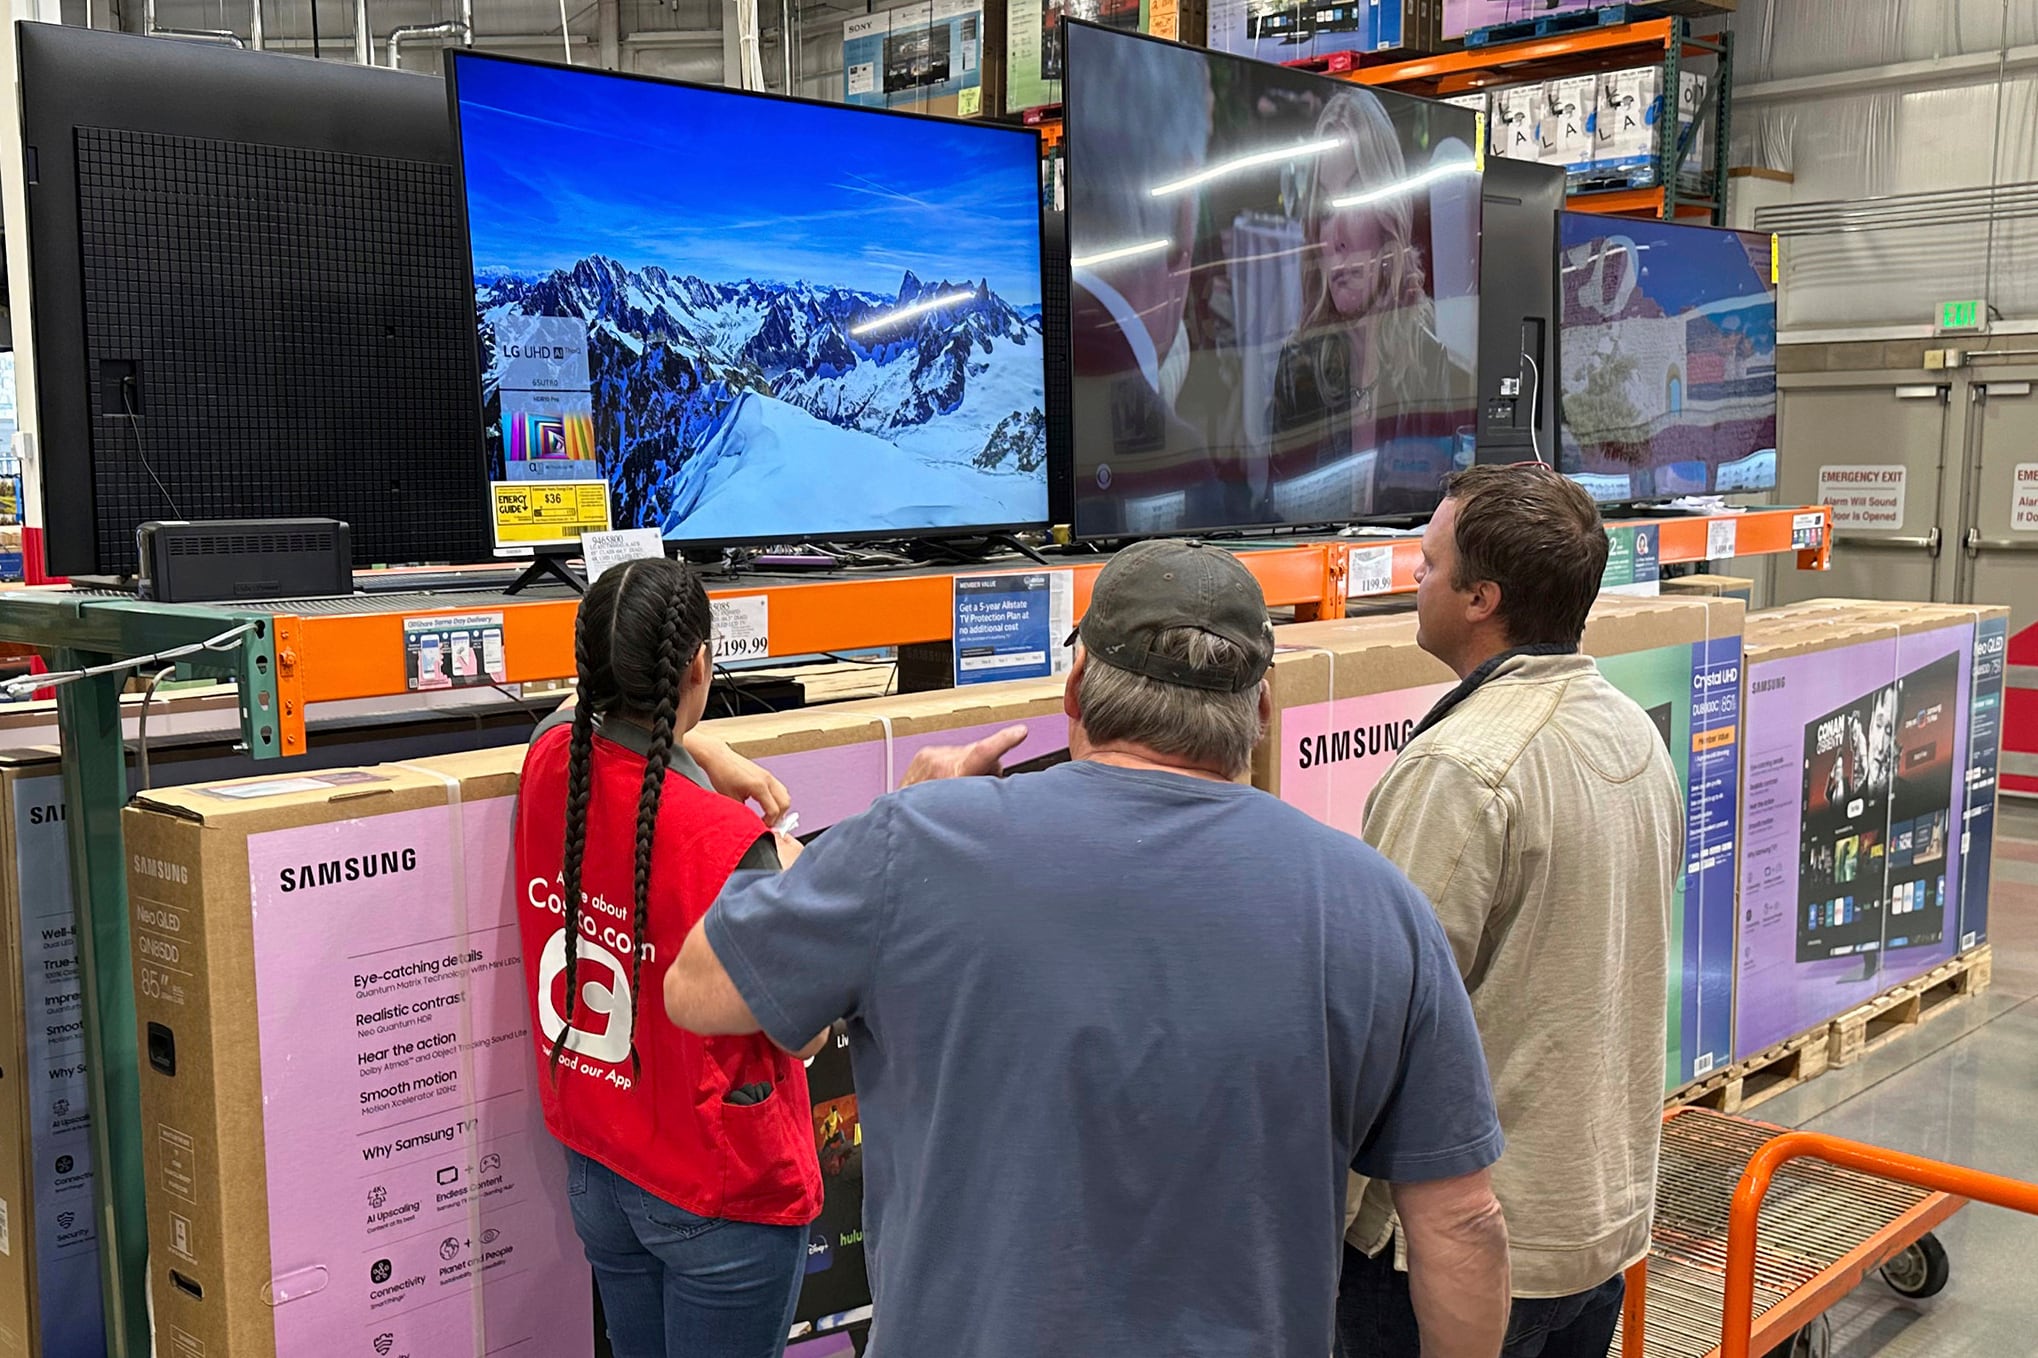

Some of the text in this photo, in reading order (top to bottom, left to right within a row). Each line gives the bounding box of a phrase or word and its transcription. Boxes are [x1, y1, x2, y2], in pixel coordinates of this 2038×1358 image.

[848, 21, 873, 33] SONY
[1944, 302, 1976, 327] EXIT
[503, 346, 521, 358] LG
[524, 346, 550, 359] UHD
[1821, 471, 1903, 482] EMERGENCY EXIT
[498, 495, 527, 505] ENERGY
[499, 504, 522, 514] GUIDE
[545, 493, 562, 504] $36
[1823, 496, 1897, 507] Alarm Will Sound
[1862, 511, 1897, 522] Opened
[1362, 576, 1391, 591] 1199.99
[959, 603, 973, 612] Get
[979, 602, 1001, 613] 5-year
[1001, 600, 1028, 609] Allstate
[960, 611, 1029, 623] TV Protection Plan at
[434, 618, 452, 626] Same
[453, 618, 466, 626] Day
[466, 616, 493, 624] Delivery
[959, 623, 1019, 635] no additional cost
[1722, 667, 1738, 684] UHD
[1751, 676, 1786, 694] SAMSUNG
[1299, 719, 1414, 769] SAMSUNG
[133, 854, 188, 885] SAMSUNG
[280, 848, 416, 892] SAMSUNG
[137, 905, 155, 925] Neo
[591, 893, 627, 921] about
[354, 949, 483, 989] Eye-catching details
[356, 985, 396, 999] Quantum
[396, 979, 422, 991] Matrix
[471, 963, 488, 974] with
[488, 959, 503, 970] Mini
[504, 956, 521, 967] LEDs
[356, 990, 466, 1026] Realistic contrast
[358, 1013, 433, 1039] Neo Quantum HDR
[358, 1032, 457, 1066] Hear the action
[360, 1065, 382, 1078] Dolby
[415, 1053, 431, 1064] and
[431, 1047, 457, 1060] Object
[491, 1032, 514, 1043] Sound
[514, 1029, 528, 1039] Lite
[360, 1070, 457, 1104] Smooth motion
[580, 1064, 603, 1078] our
[605, 1069, 632, 1090] App
[361, 1101, 391, 1116] Motion
[391, 1091, 435, 1108] Xcelerator
[362, 1118, 479, 1160] Why Samsung TV?
[436, 1186, 468, 1202] Endless
[366, 1202, 420, 1224] AI Upscaling
[840, 1229, 864, 1246] hulu
[439, 1261, 466, 1276] Planet
[485, 1245, 514, 1262] People
[370, 1275, 426, 1300] Connectivity
